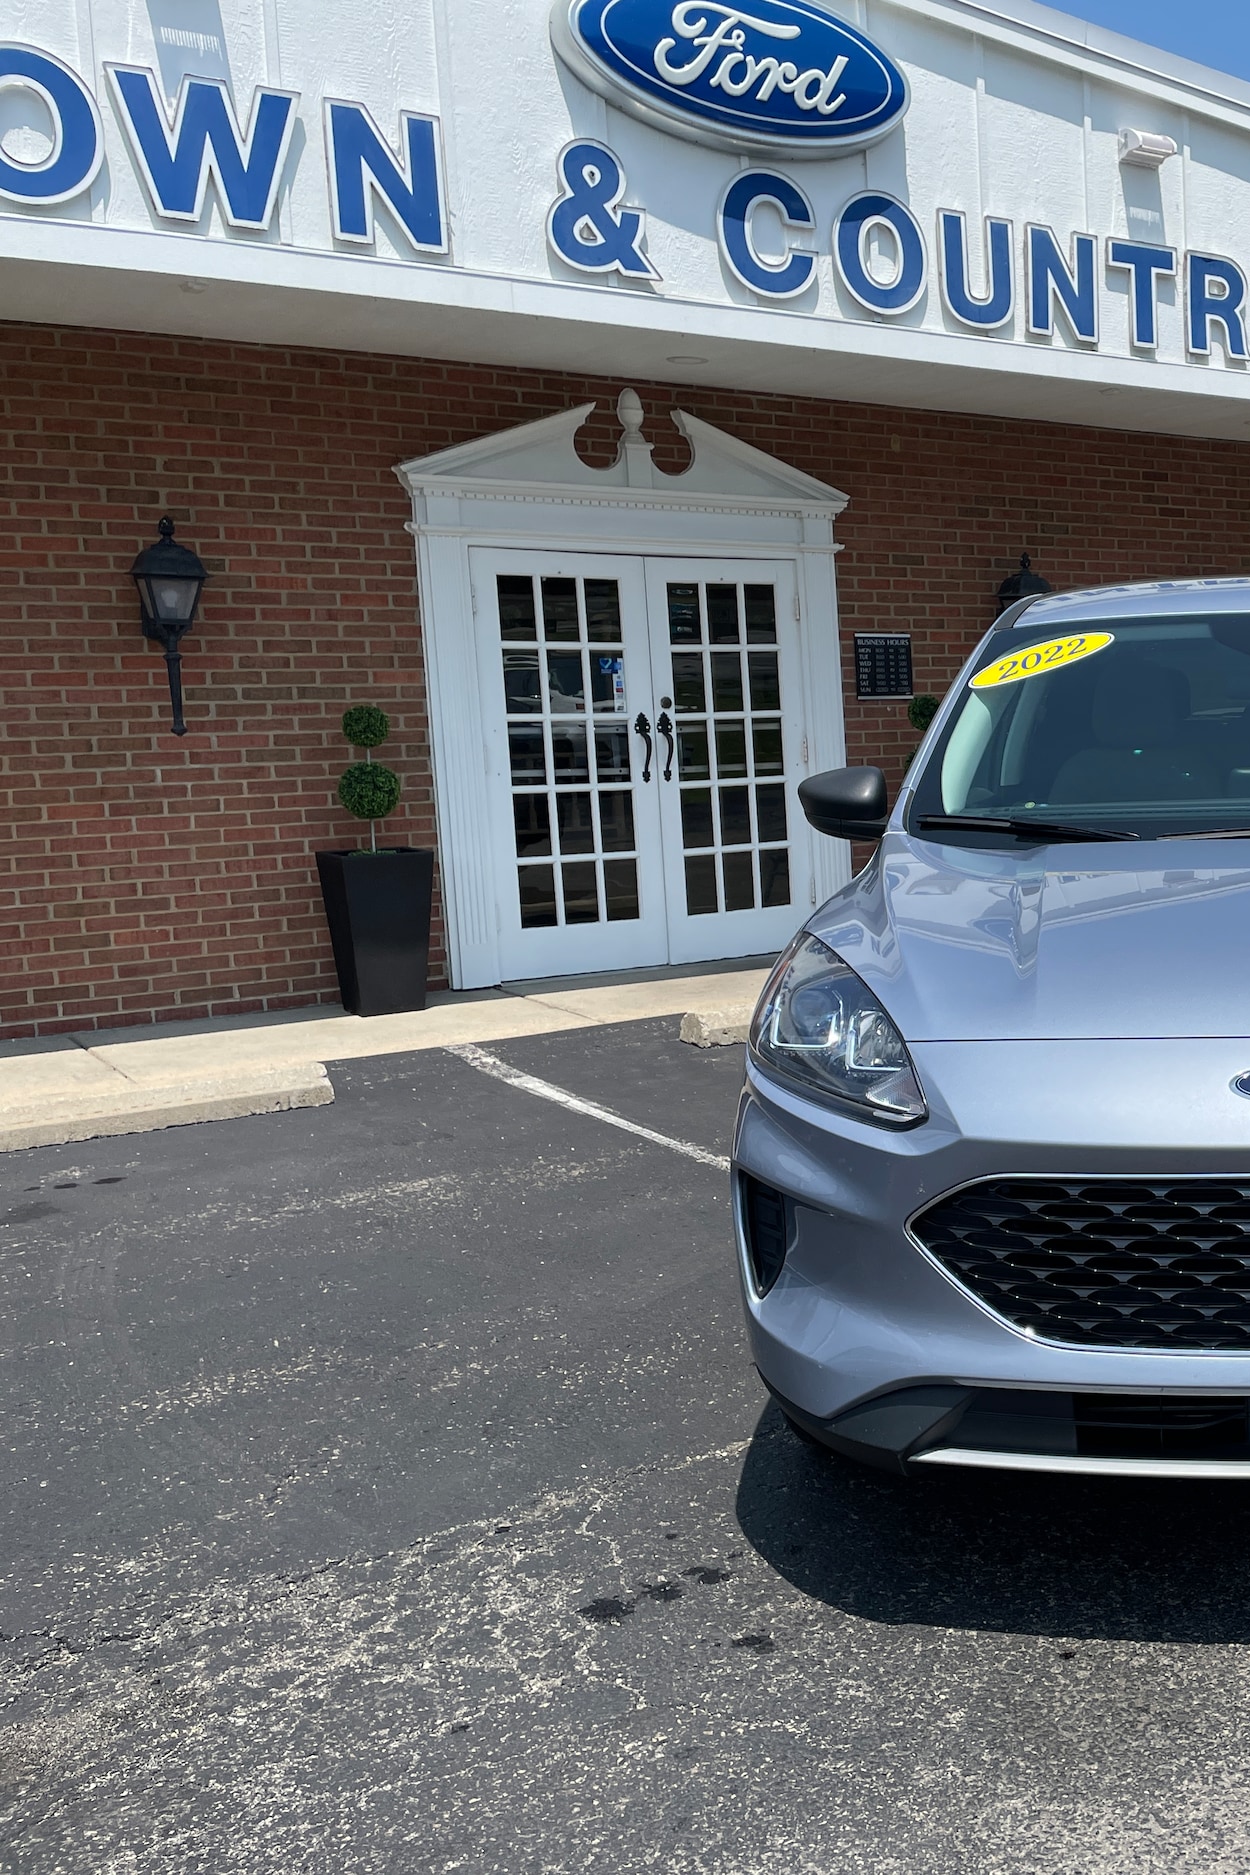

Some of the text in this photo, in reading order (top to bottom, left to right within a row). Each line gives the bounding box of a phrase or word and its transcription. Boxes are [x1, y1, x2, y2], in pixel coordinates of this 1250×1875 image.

[654, 0, 849, 115] Ford
[547, 137, 662, 281] &
[998, 638, 1087, 681] 2022
